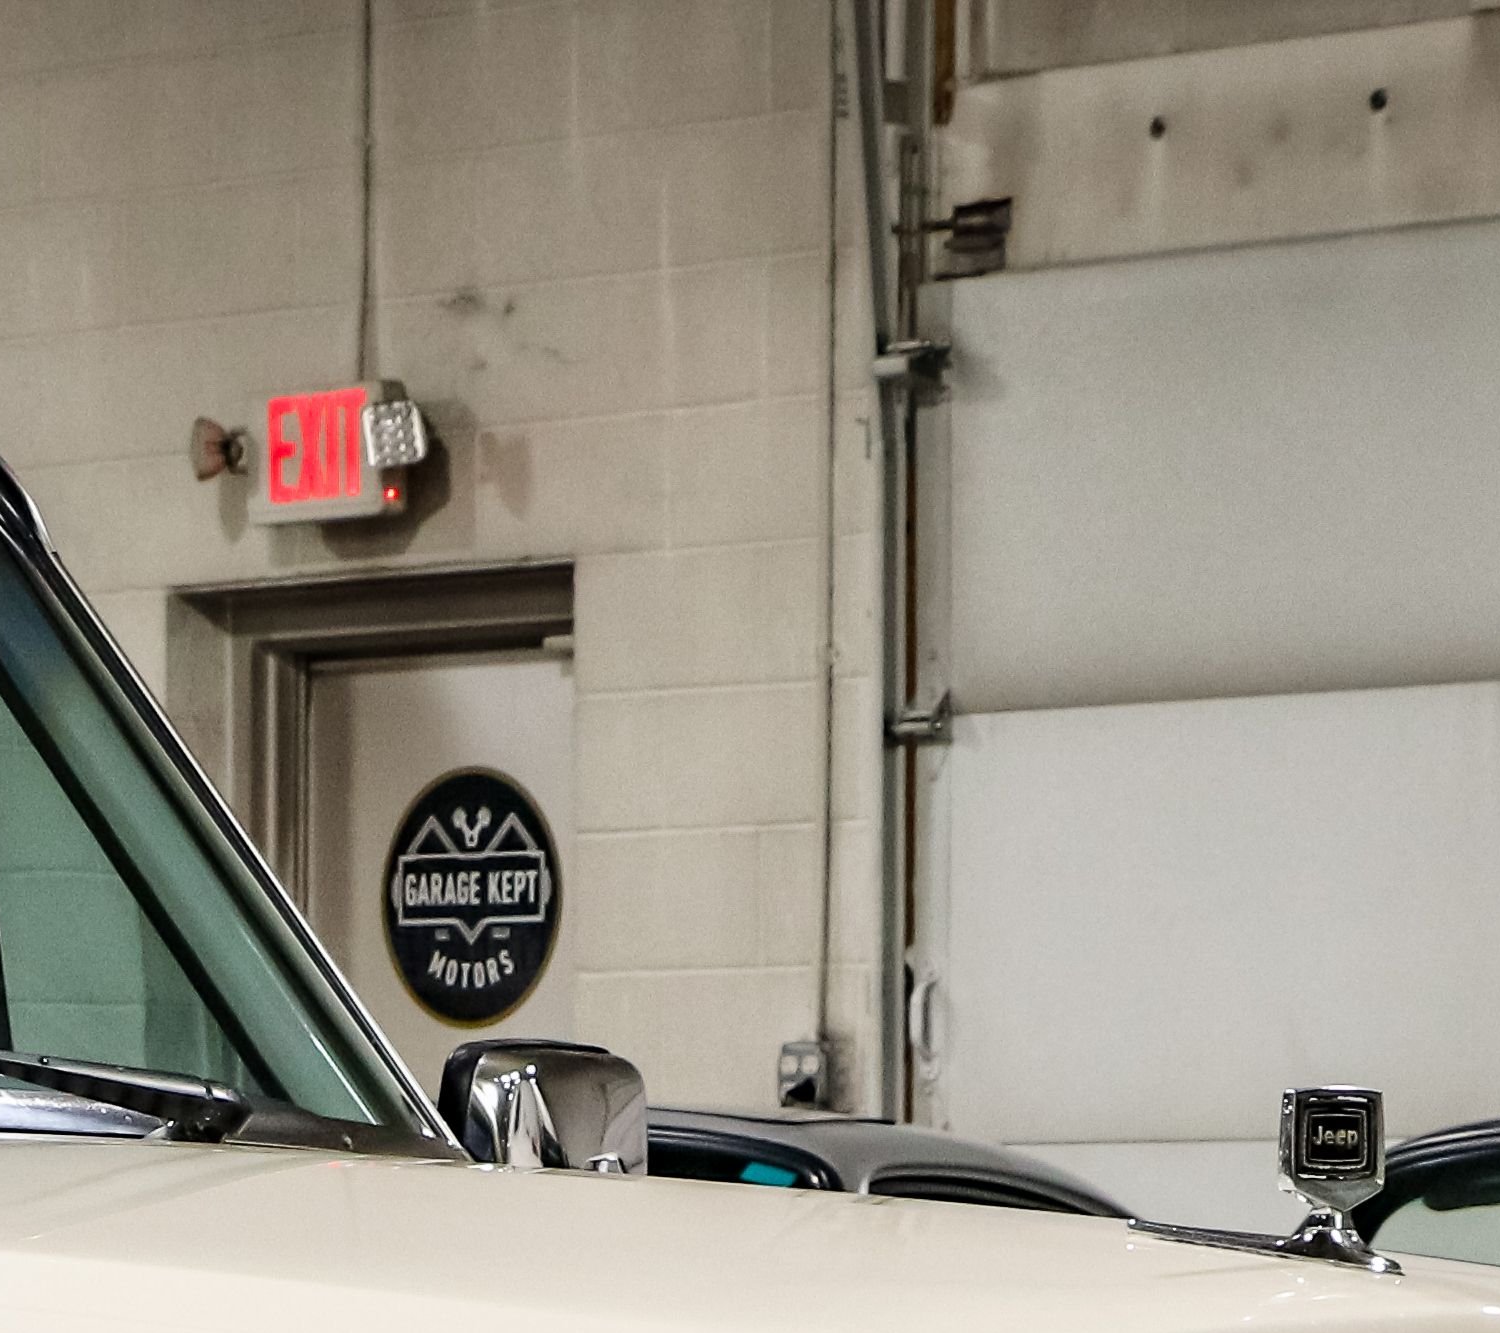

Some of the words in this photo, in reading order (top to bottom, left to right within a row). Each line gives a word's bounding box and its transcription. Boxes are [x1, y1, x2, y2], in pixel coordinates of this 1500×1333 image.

[268, 387, 368, 504] EXIT
[405, 871, 480, 907] GARAGE
[488, 869, 538, 904] KEPT
[428, 948, 515, 989] MOTORS
[1312, 1124, 1358, 1151] Jeep
